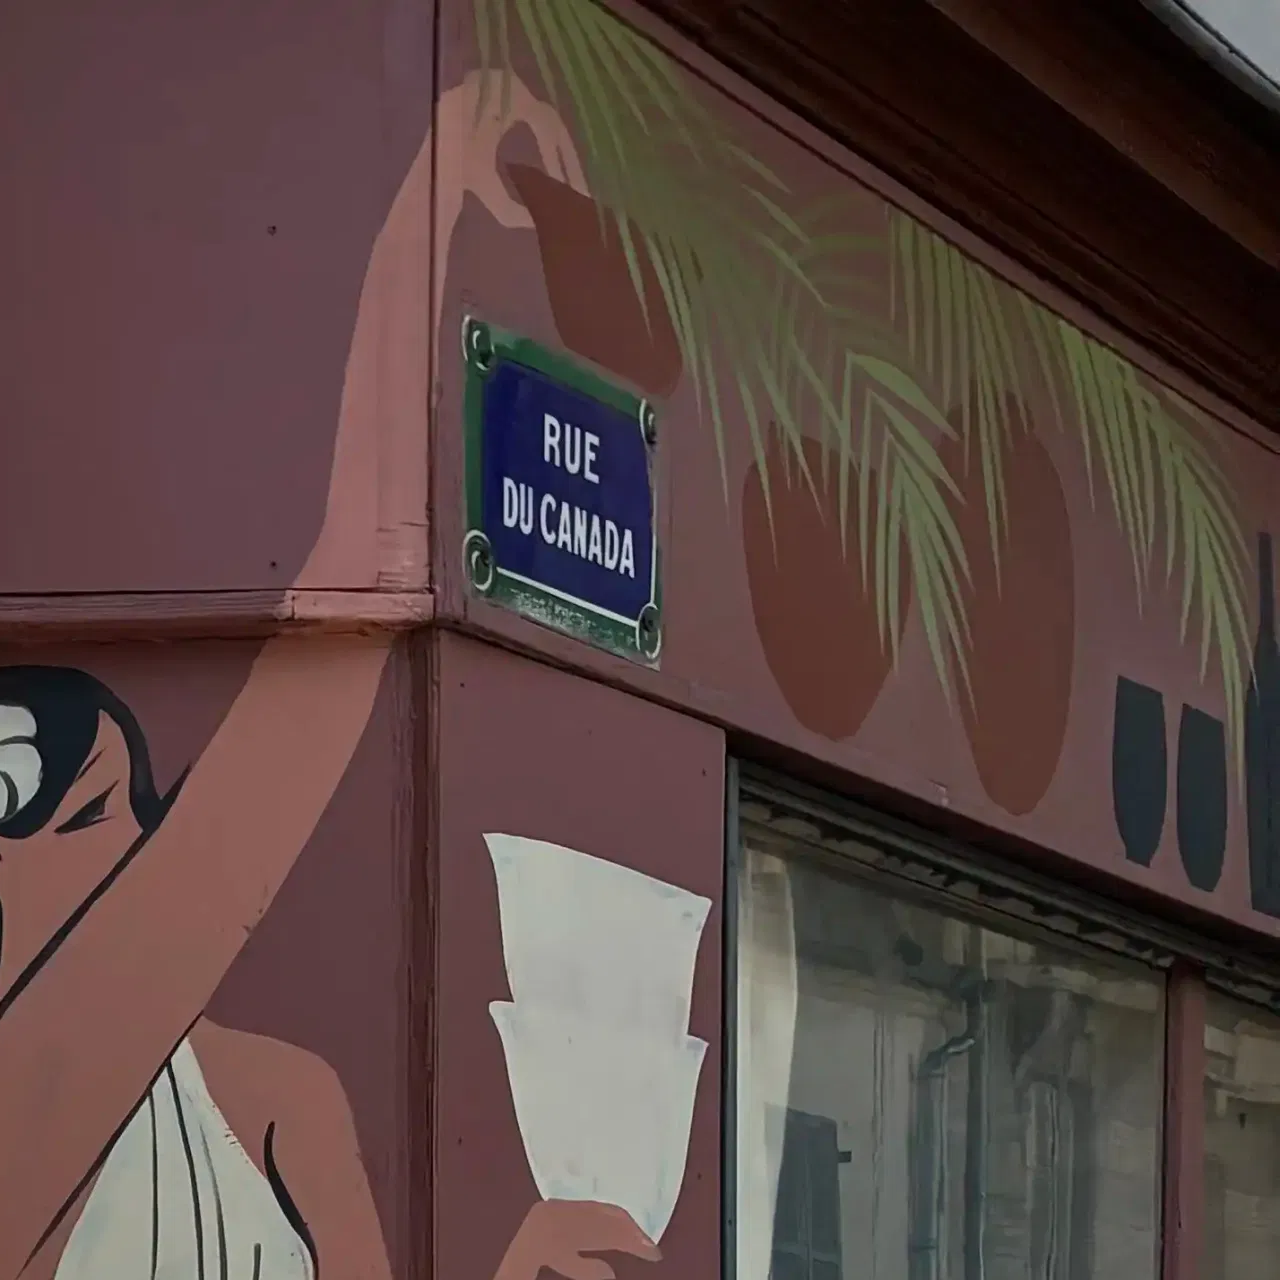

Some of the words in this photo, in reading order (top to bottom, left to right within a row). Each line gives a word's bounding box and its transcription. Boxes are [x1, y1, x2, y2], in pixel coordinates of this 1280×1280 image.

[543, 412, 600, 484] RUE
[502, 476, 534, 536] DU
[540, 493, 636, 579] CANADA
